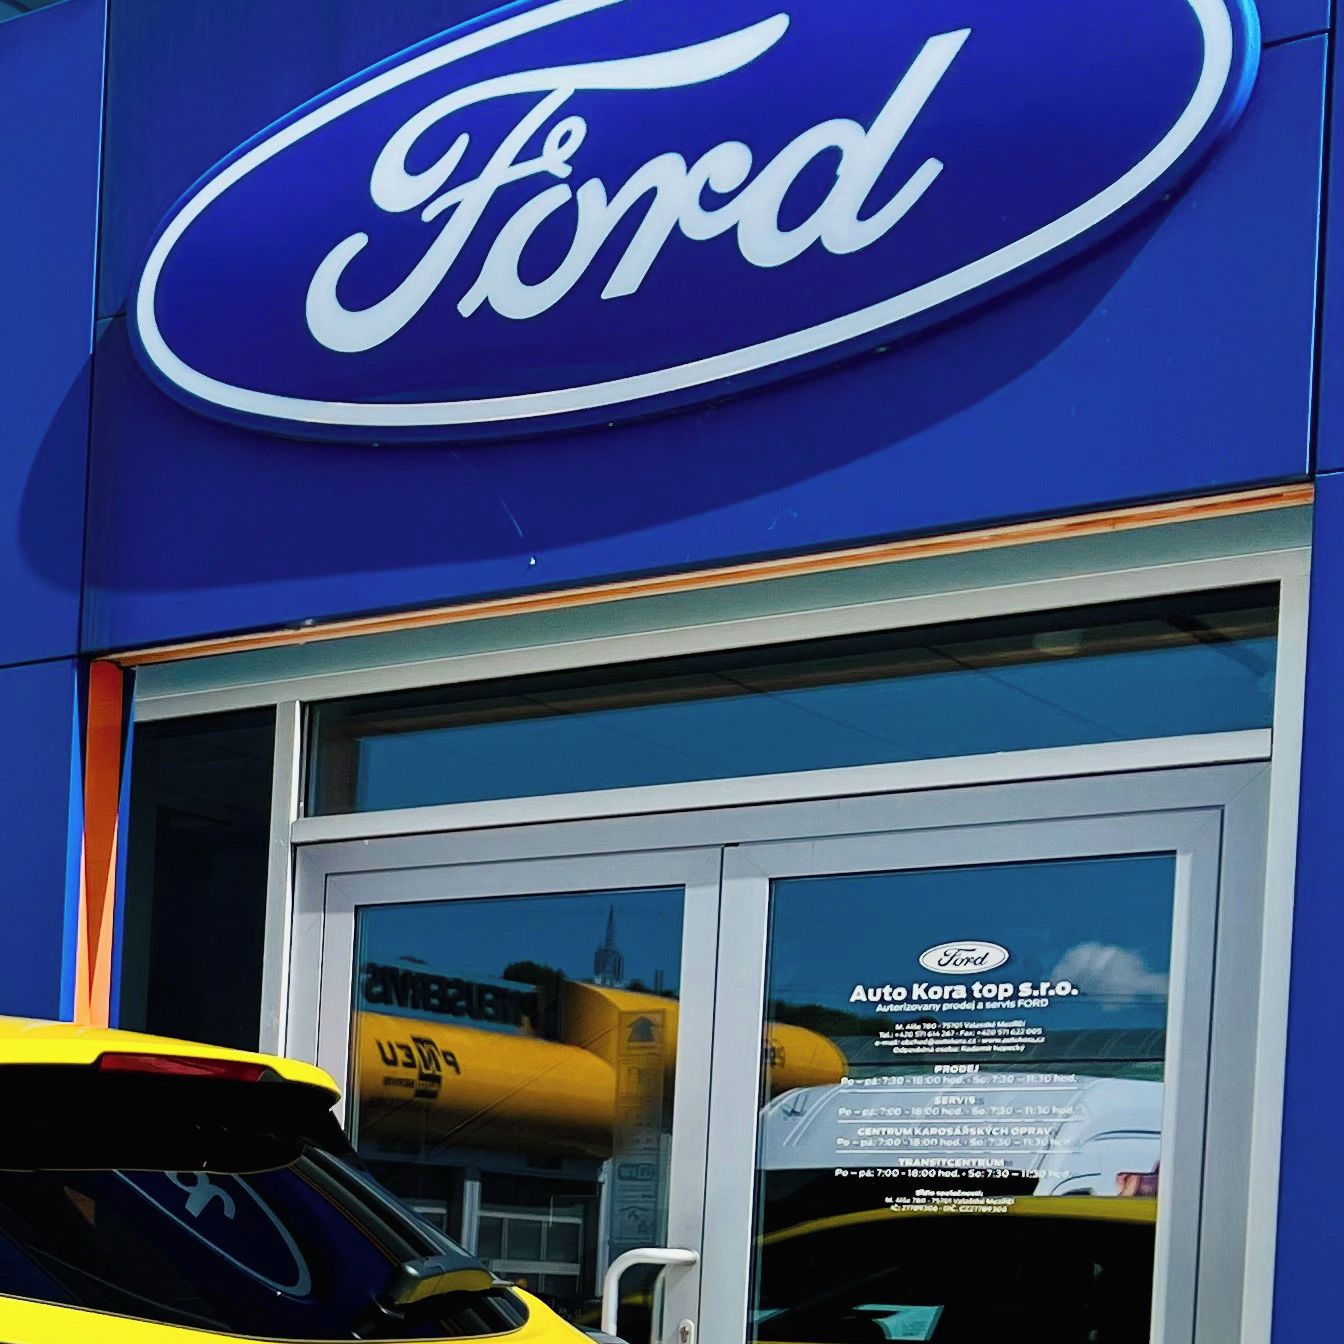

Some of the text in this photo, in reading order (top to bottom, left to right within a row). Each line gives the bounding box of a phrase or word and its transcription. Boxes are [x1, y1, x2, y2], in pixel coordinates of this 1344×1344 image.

[305, 13, 970, 353] Ford
[938, 948, 989, 967] Ford
[850, 980, 1079, 1003] Auto Kora top s.r.o.
[943, 1001, 975, 1012] prodej
[985, 1000, 1016, 1009] servis
[1017, 998, 1049, 1009] FORD
[934, 1064, 979, 1074] PRODEJ
[841, 1076, 854, 1086] Po
[934, 1095, 975, 1105] SERVIS
[858, 1127, 912, 1136] CENTRUM
[1011, 1126, 1052, 1136] OPRAV
[835, 1168, 848, 1177] Po
[877, 1168, 899, 1177] 7:00
[937, 1168, 960, 1177] hod.
[968, 1168, 985, 1178] So:
[986, 1168, 1009, 1178] 7:30
